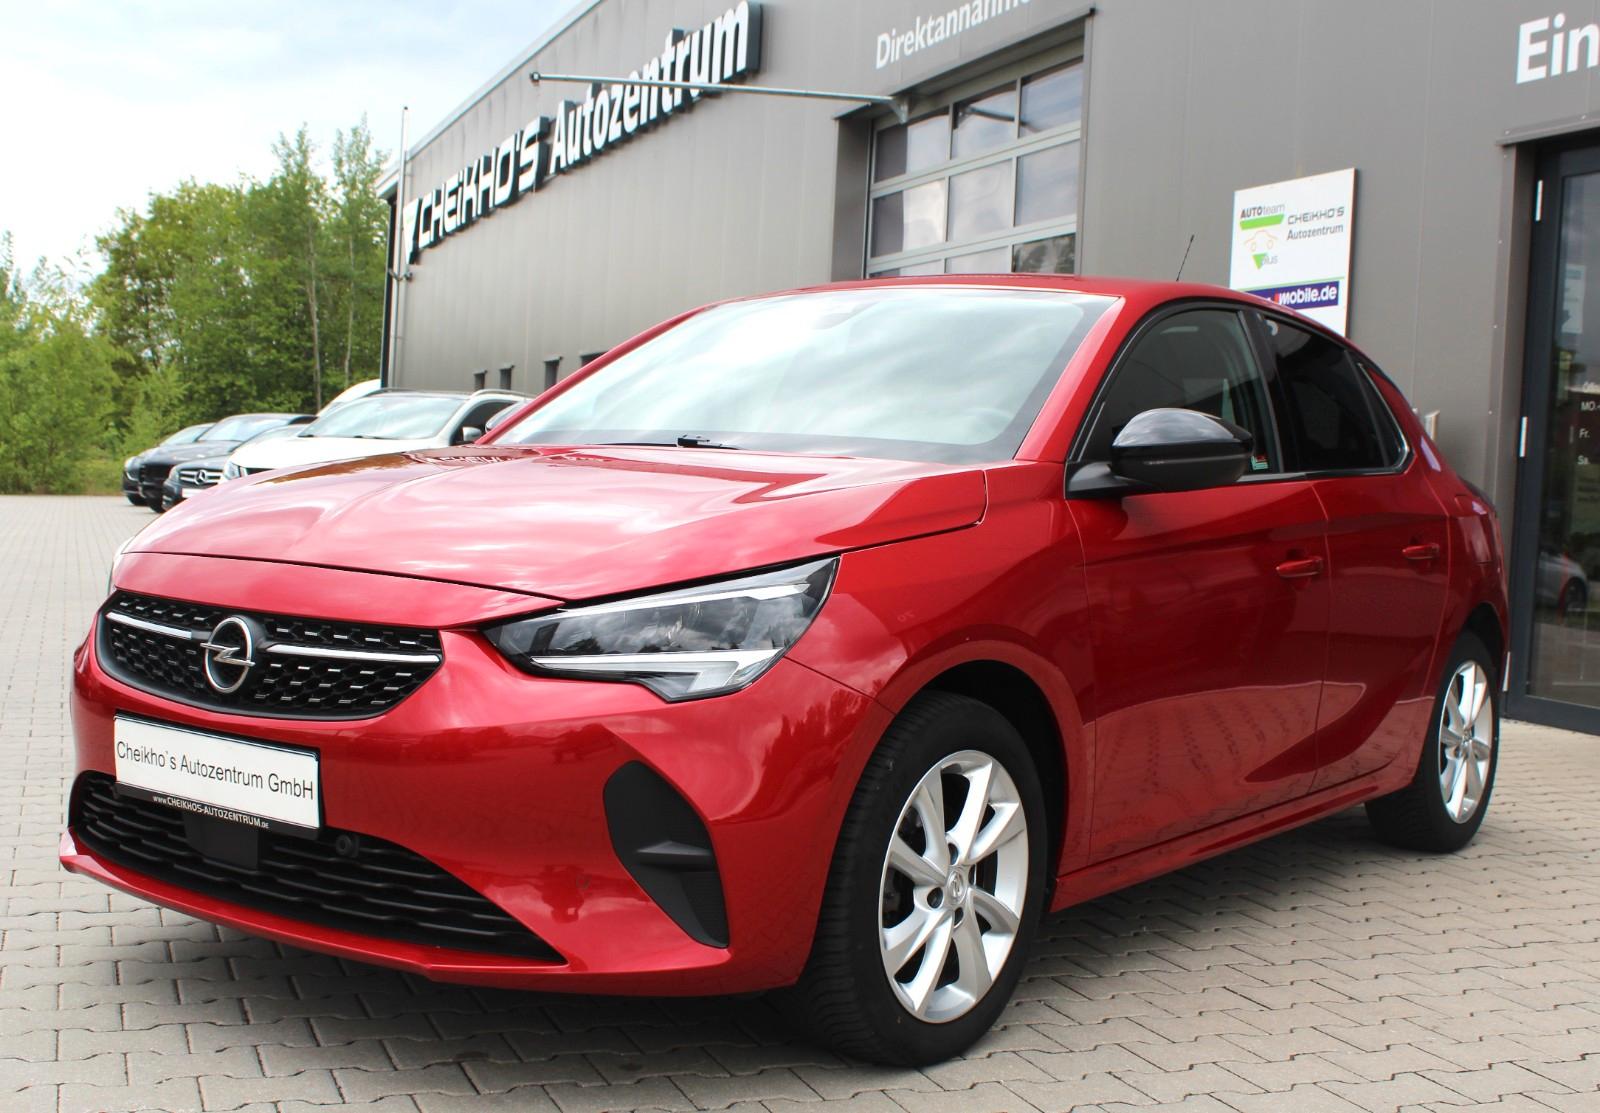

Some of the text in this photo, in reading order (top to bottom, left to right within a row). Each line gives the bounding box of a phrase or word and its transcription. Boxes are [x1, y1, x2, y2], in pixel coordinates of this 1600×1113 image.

[549, 0, 754, 175] Autozentrum
[1287, 224, 1343, 241] Autozentrum
[1279, 285, 1337, 305] mobile.de
[180, 754, 264, 790] Autozentrum
[267, 772, 314, 801] GmbH
